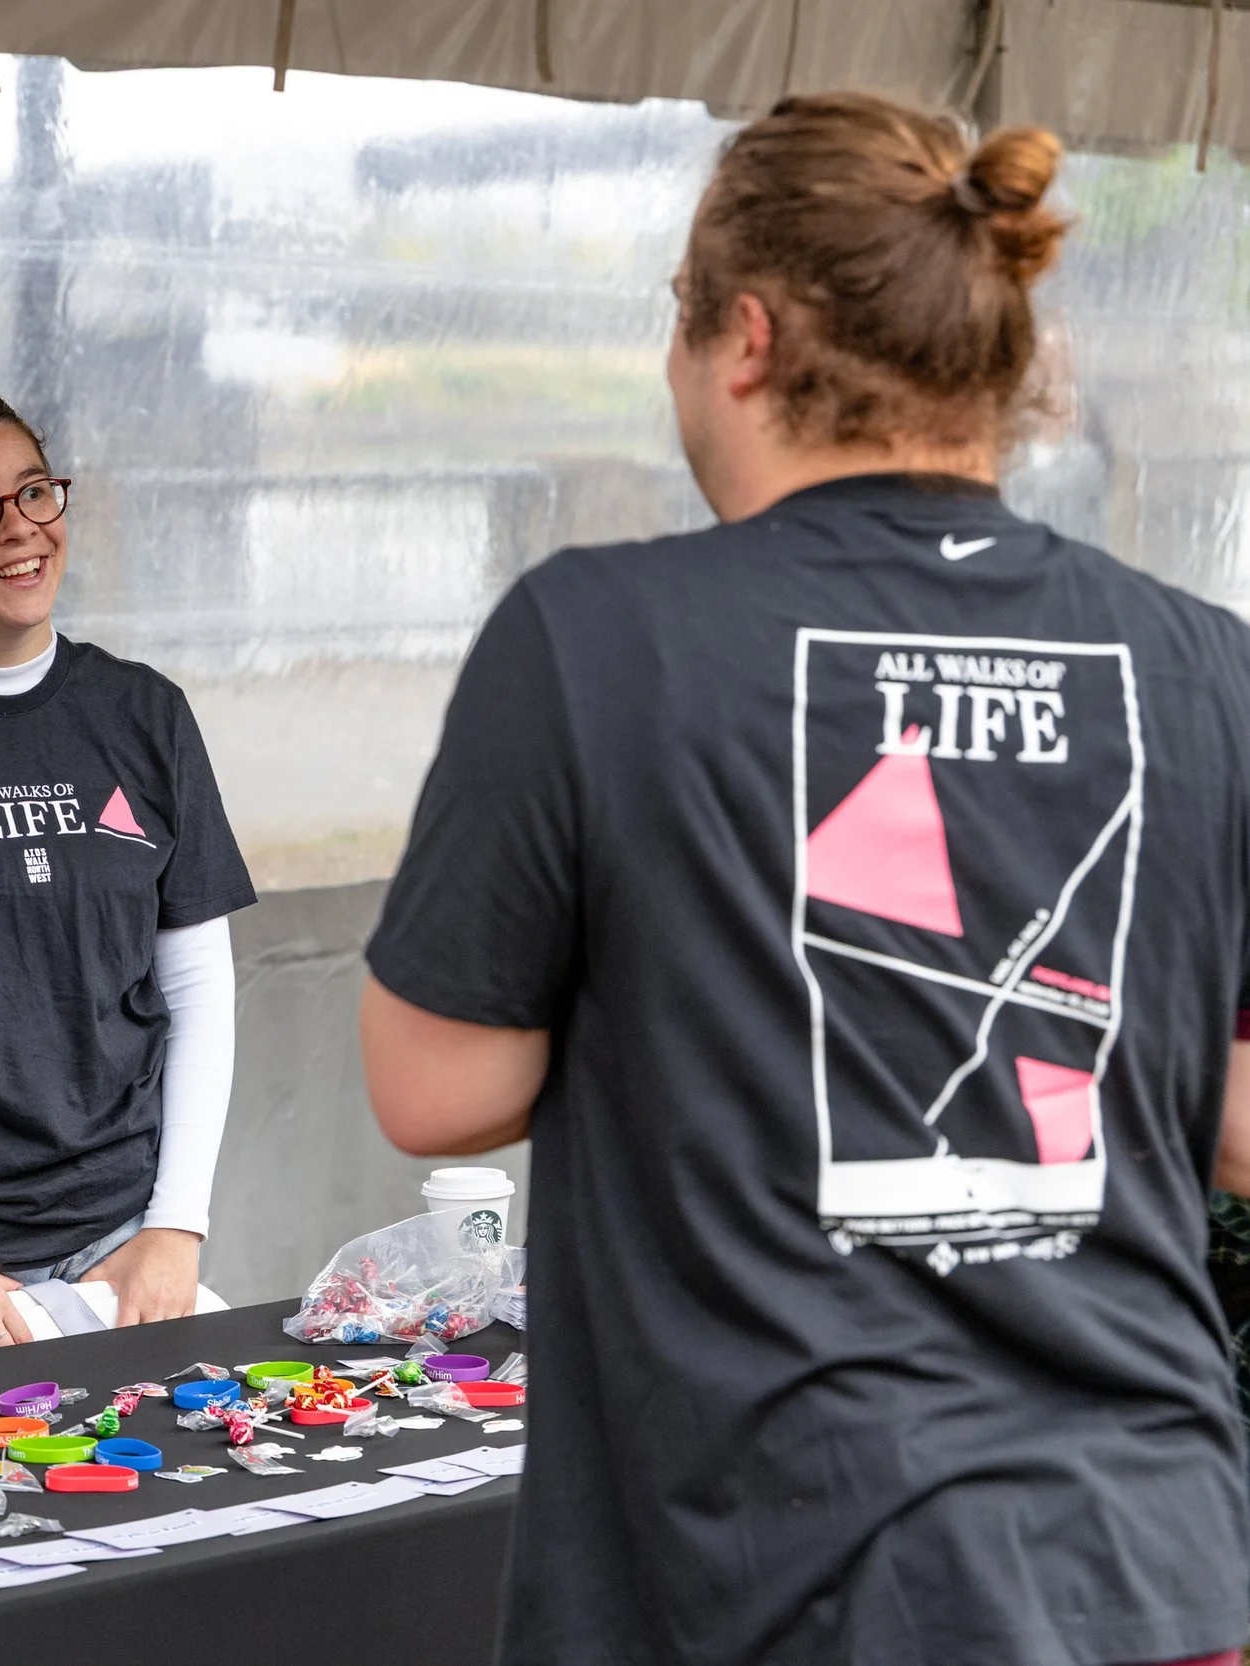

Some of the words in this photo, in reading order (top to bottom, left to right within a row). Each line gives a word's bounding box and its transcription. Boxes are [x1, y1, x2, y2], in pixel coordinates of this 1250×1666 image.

[875, 652, 934, 682] ALL
[934, 653, 1026, 687] WALKS
[1026, 660, 1067, 689] OF
[875, 681, 1068, 763] LIFE
[53, 783, 74, 796] OF
[24, 848, 47, 858] AIDS
[24, 856, 49, 866] WALK
[26, 864, 51, 874] NORTH
[28, 873, 52, 884] WEST
[16, 1400, 52, 1414] He/Him
